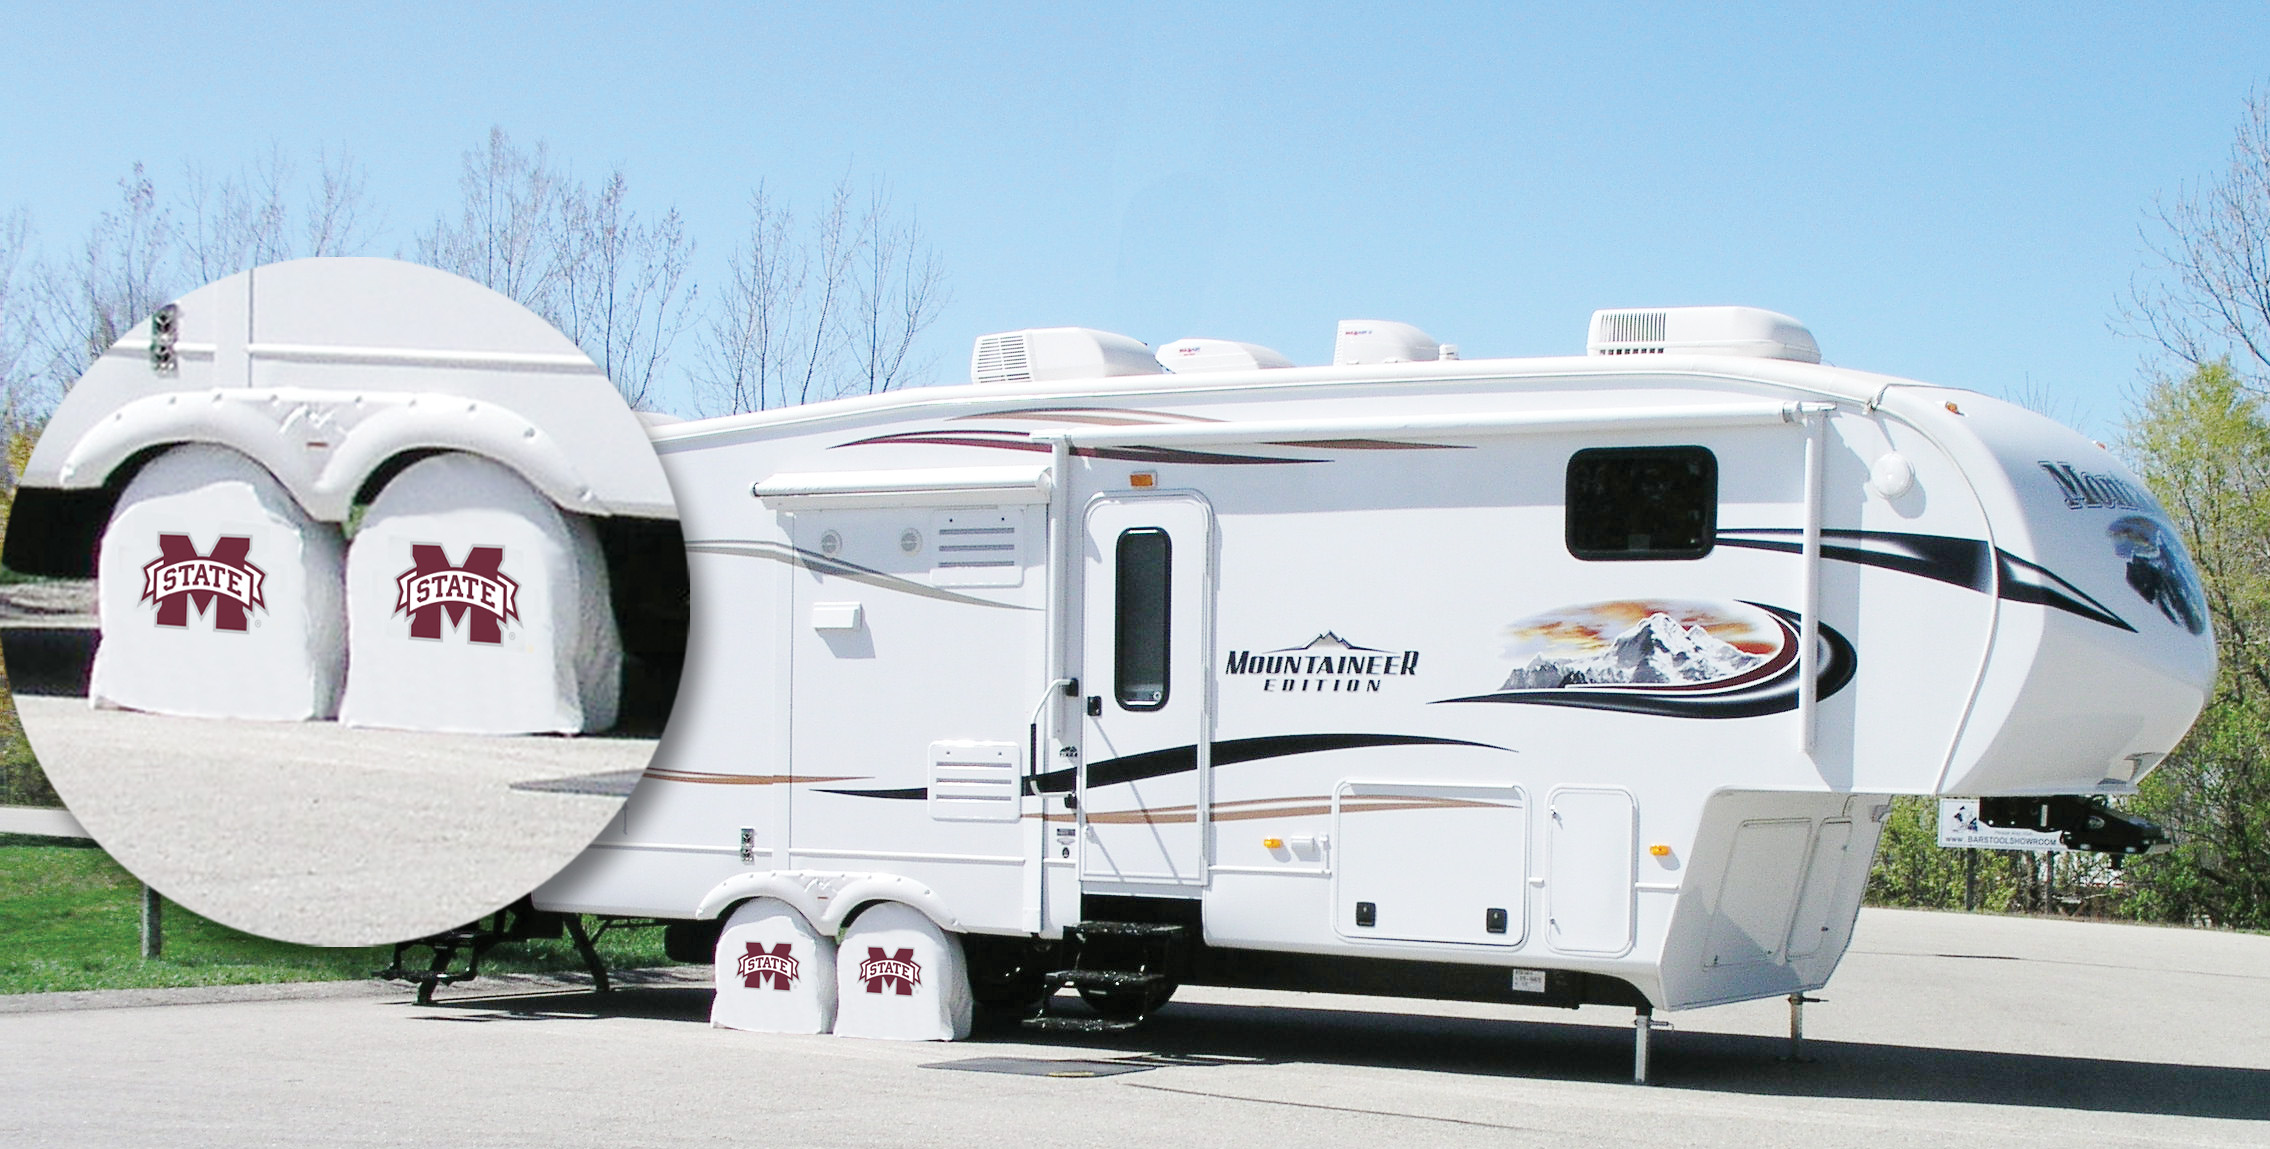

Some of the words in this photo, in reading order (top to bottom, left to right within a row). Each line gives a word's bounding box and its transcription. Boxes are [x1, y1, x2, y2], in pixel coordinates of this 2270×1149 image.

[163, 563, 243, 598] STATE
[416, 574, 496, 609] STATE
[1225, 650, 1420, 676] MOUNTAINEER
[1263, 678, 1382, 693] EDITION
[747, 956, 789, 974] STATE
[869, 961, 911, 979] STATE
